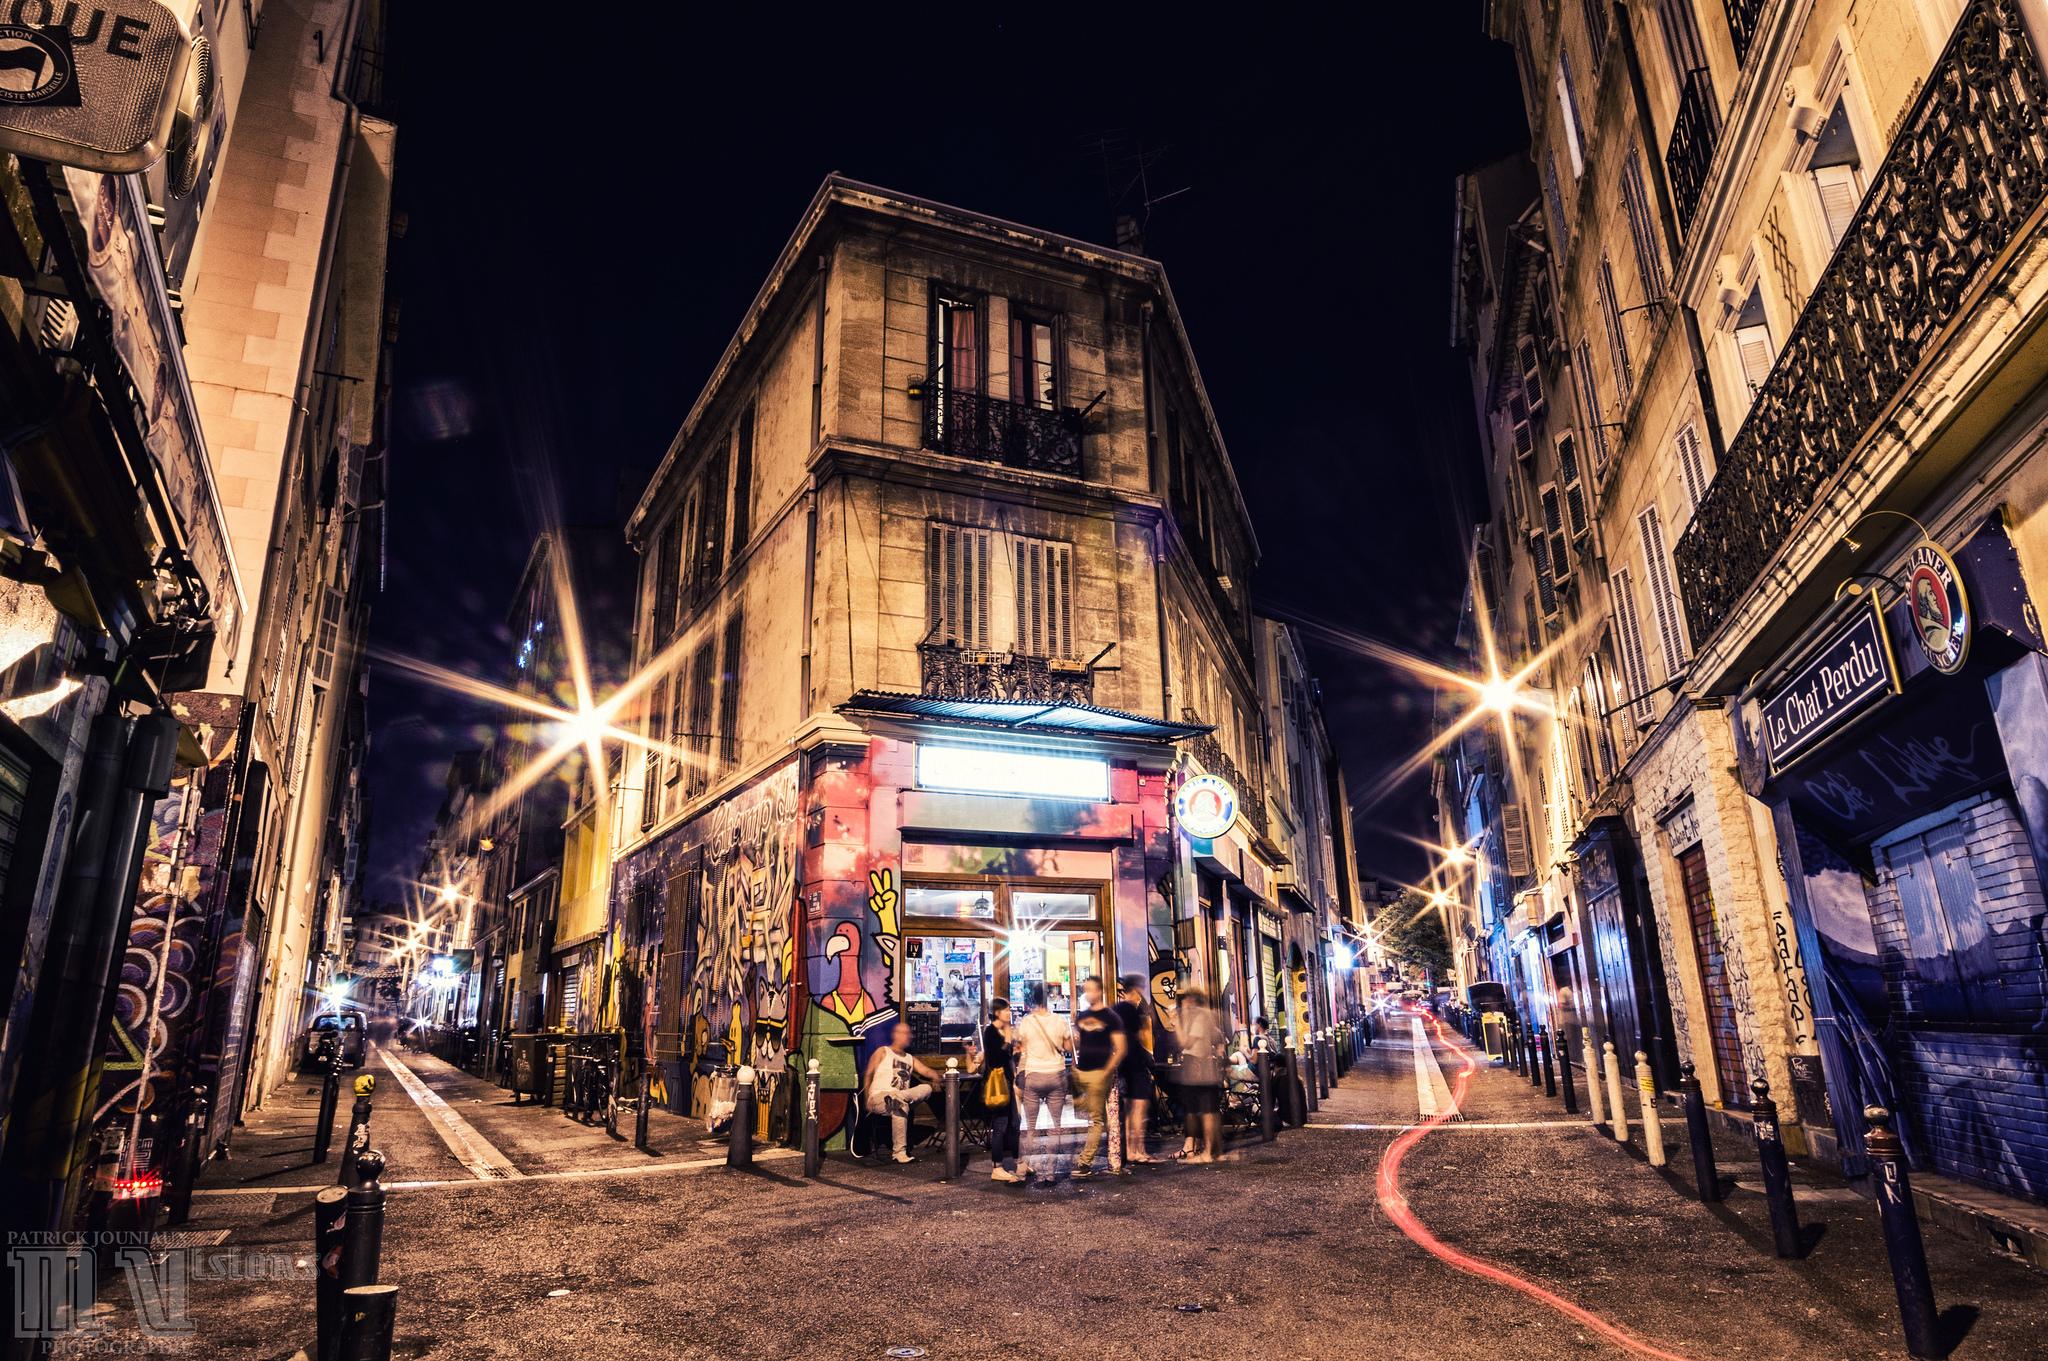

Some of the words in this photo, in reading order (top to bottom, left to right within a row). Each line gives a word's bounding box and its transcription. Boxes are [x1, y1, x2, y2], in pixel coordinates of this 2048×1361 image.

[27, 71, 64, 99] MARSEILLE
[1767, 714, 1787, 750] Le
[1786, 679, 1823, 734] Chat
[1819, 640, 1878, 709] Perdu
